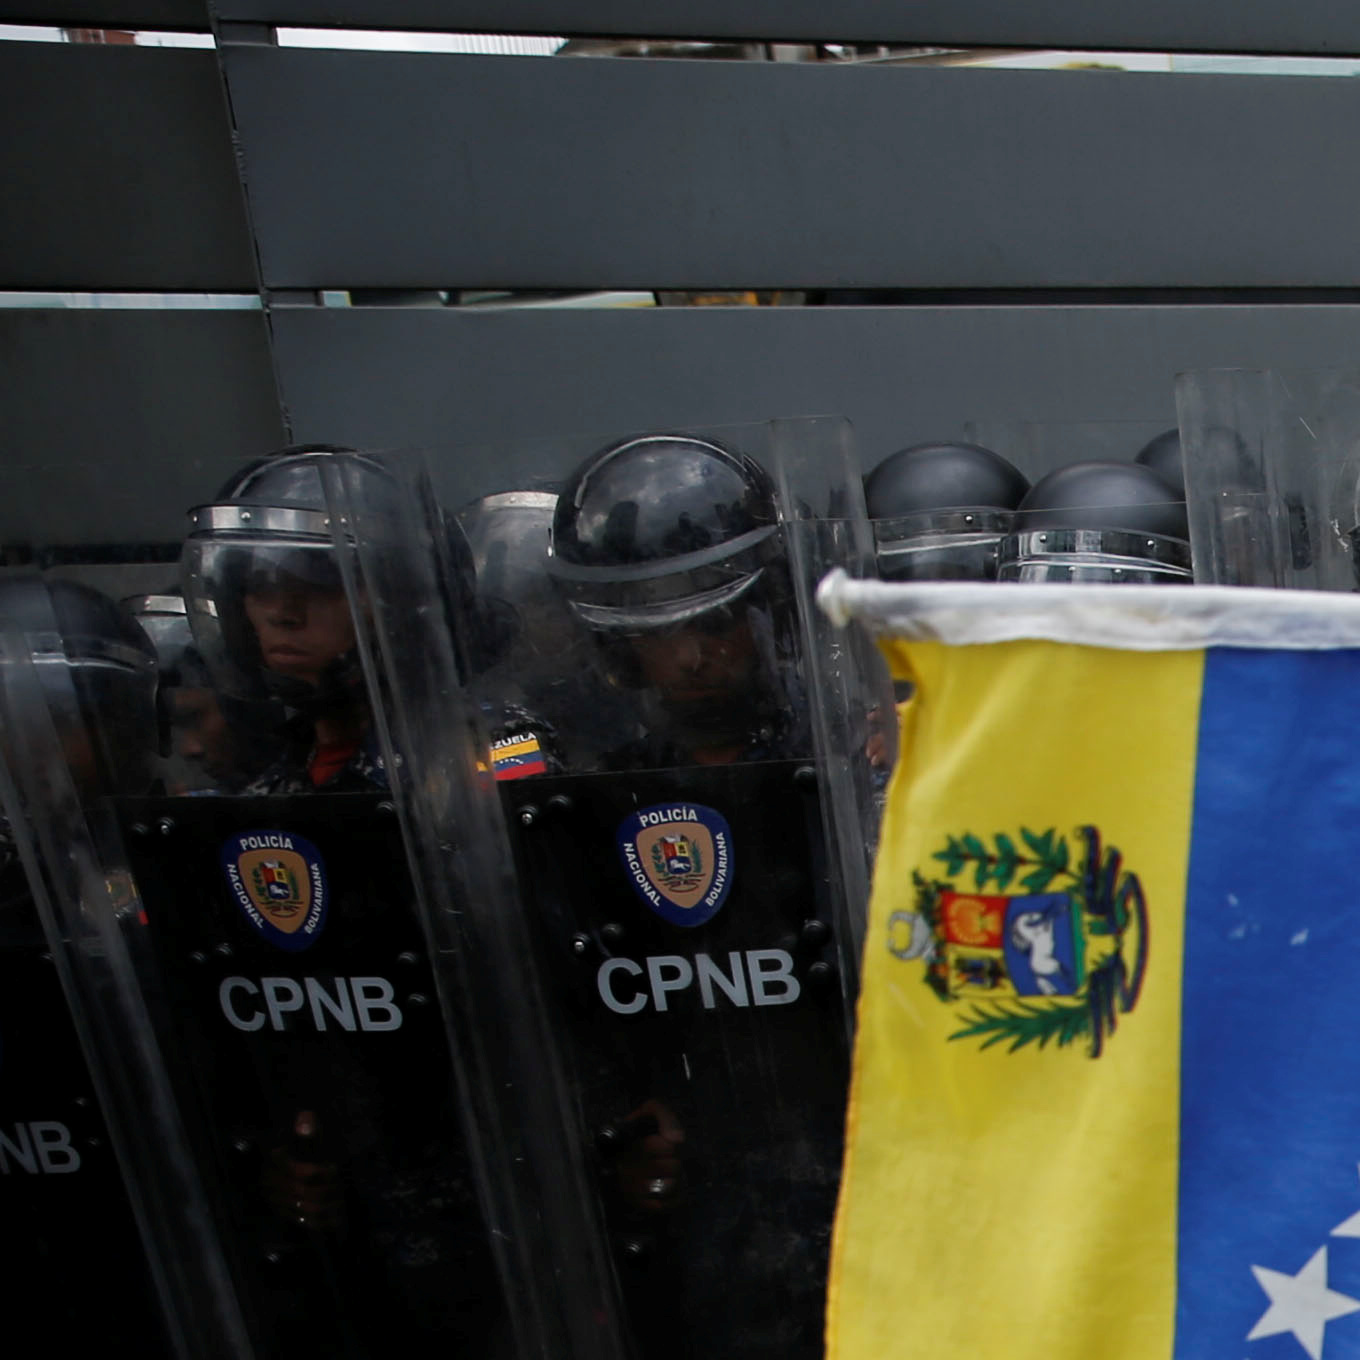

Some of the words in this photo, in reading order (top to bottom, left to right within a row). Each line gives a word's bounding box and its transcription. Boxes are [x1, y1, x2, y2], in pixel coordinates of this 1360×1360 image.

[239, 833, 294, 851] POLICÍA
[639, 806, 698, 827] POLICÍA
[227, 863, 264, 929] NACIONAL
[304, 863, 323, 935] BOLIVARIANA
[624, 843, 660, 906] NACIONAL
[705, 832, 728, 906] BOLIVARIANA
[220, 975, 403, 1033] CPNB
[596, 947, 802, 1016] CPNB
